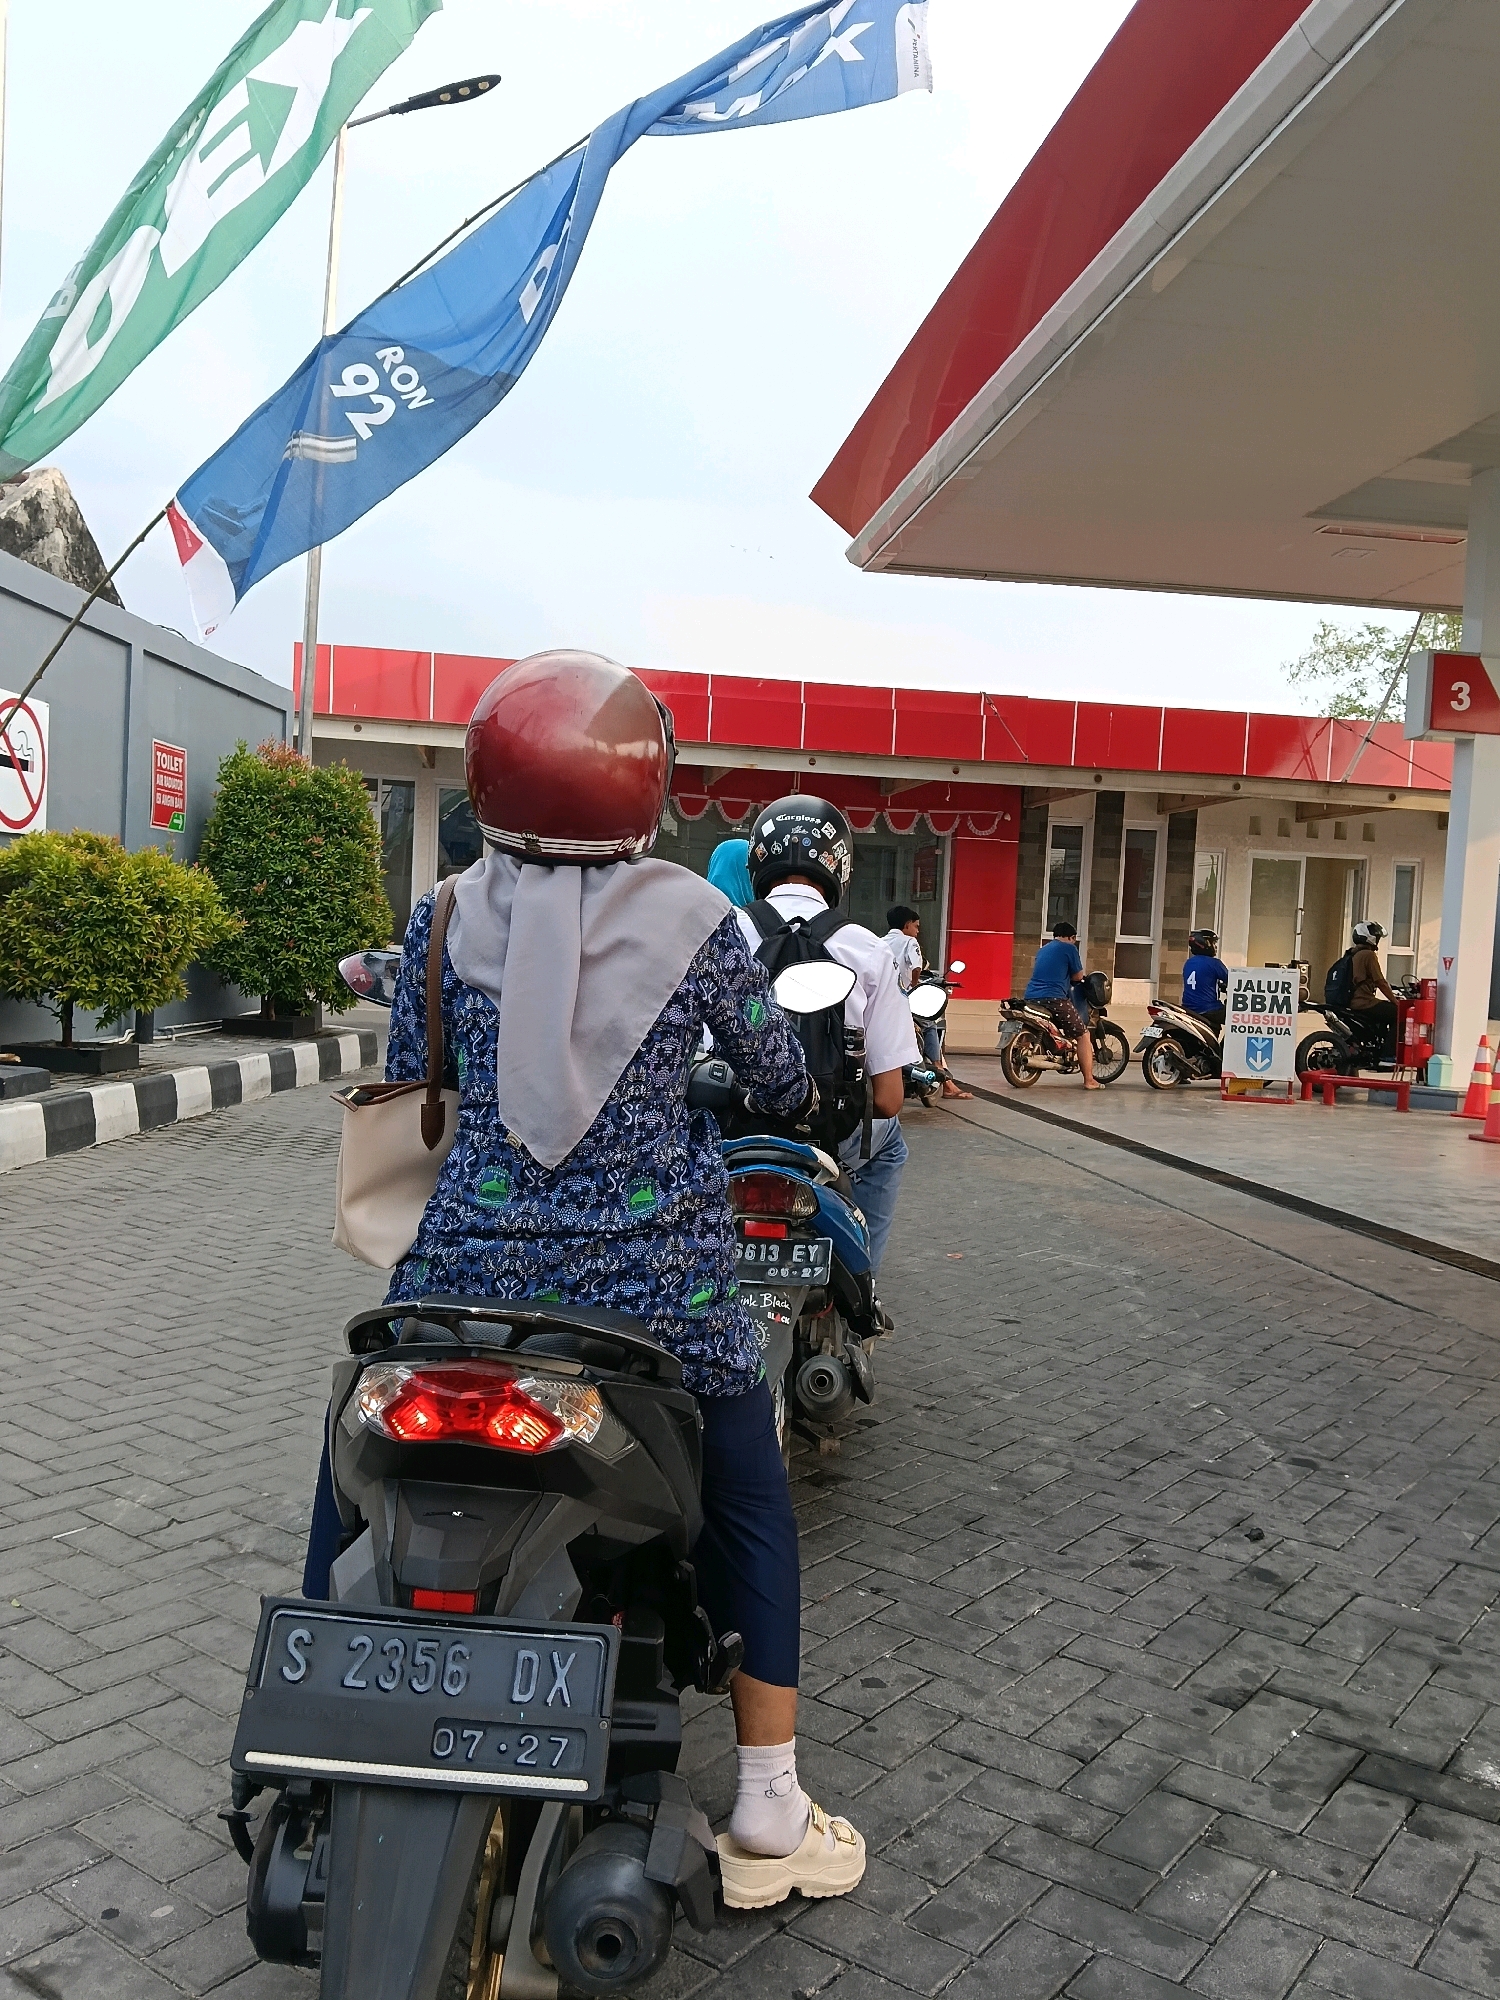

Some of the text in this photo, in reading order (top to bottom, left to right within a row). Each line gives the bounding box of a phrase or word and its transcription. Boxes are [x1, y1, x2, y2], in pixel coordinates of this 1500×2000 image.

[374, 345, 435, 410] RON
[329, 363, 396, 441] 92
[1450, 681, 1471, 711] 3
[156, 751, 183, 773] TOILET
[1187, 970, 1197, 990] 4
[1233, 979, 1292, 994] JALUR
[1232, 993, 1292, 1014] BBM
[1231, 1013, 1292, 1026] SUBSIDI
[1230, 1025, 1292, 1036] RODA DUA
[792, 1244, 819, 1262] EY
[760, 1293, 791, 1310] Black
[282, 1629, 577, 1708] S 2356 DX
